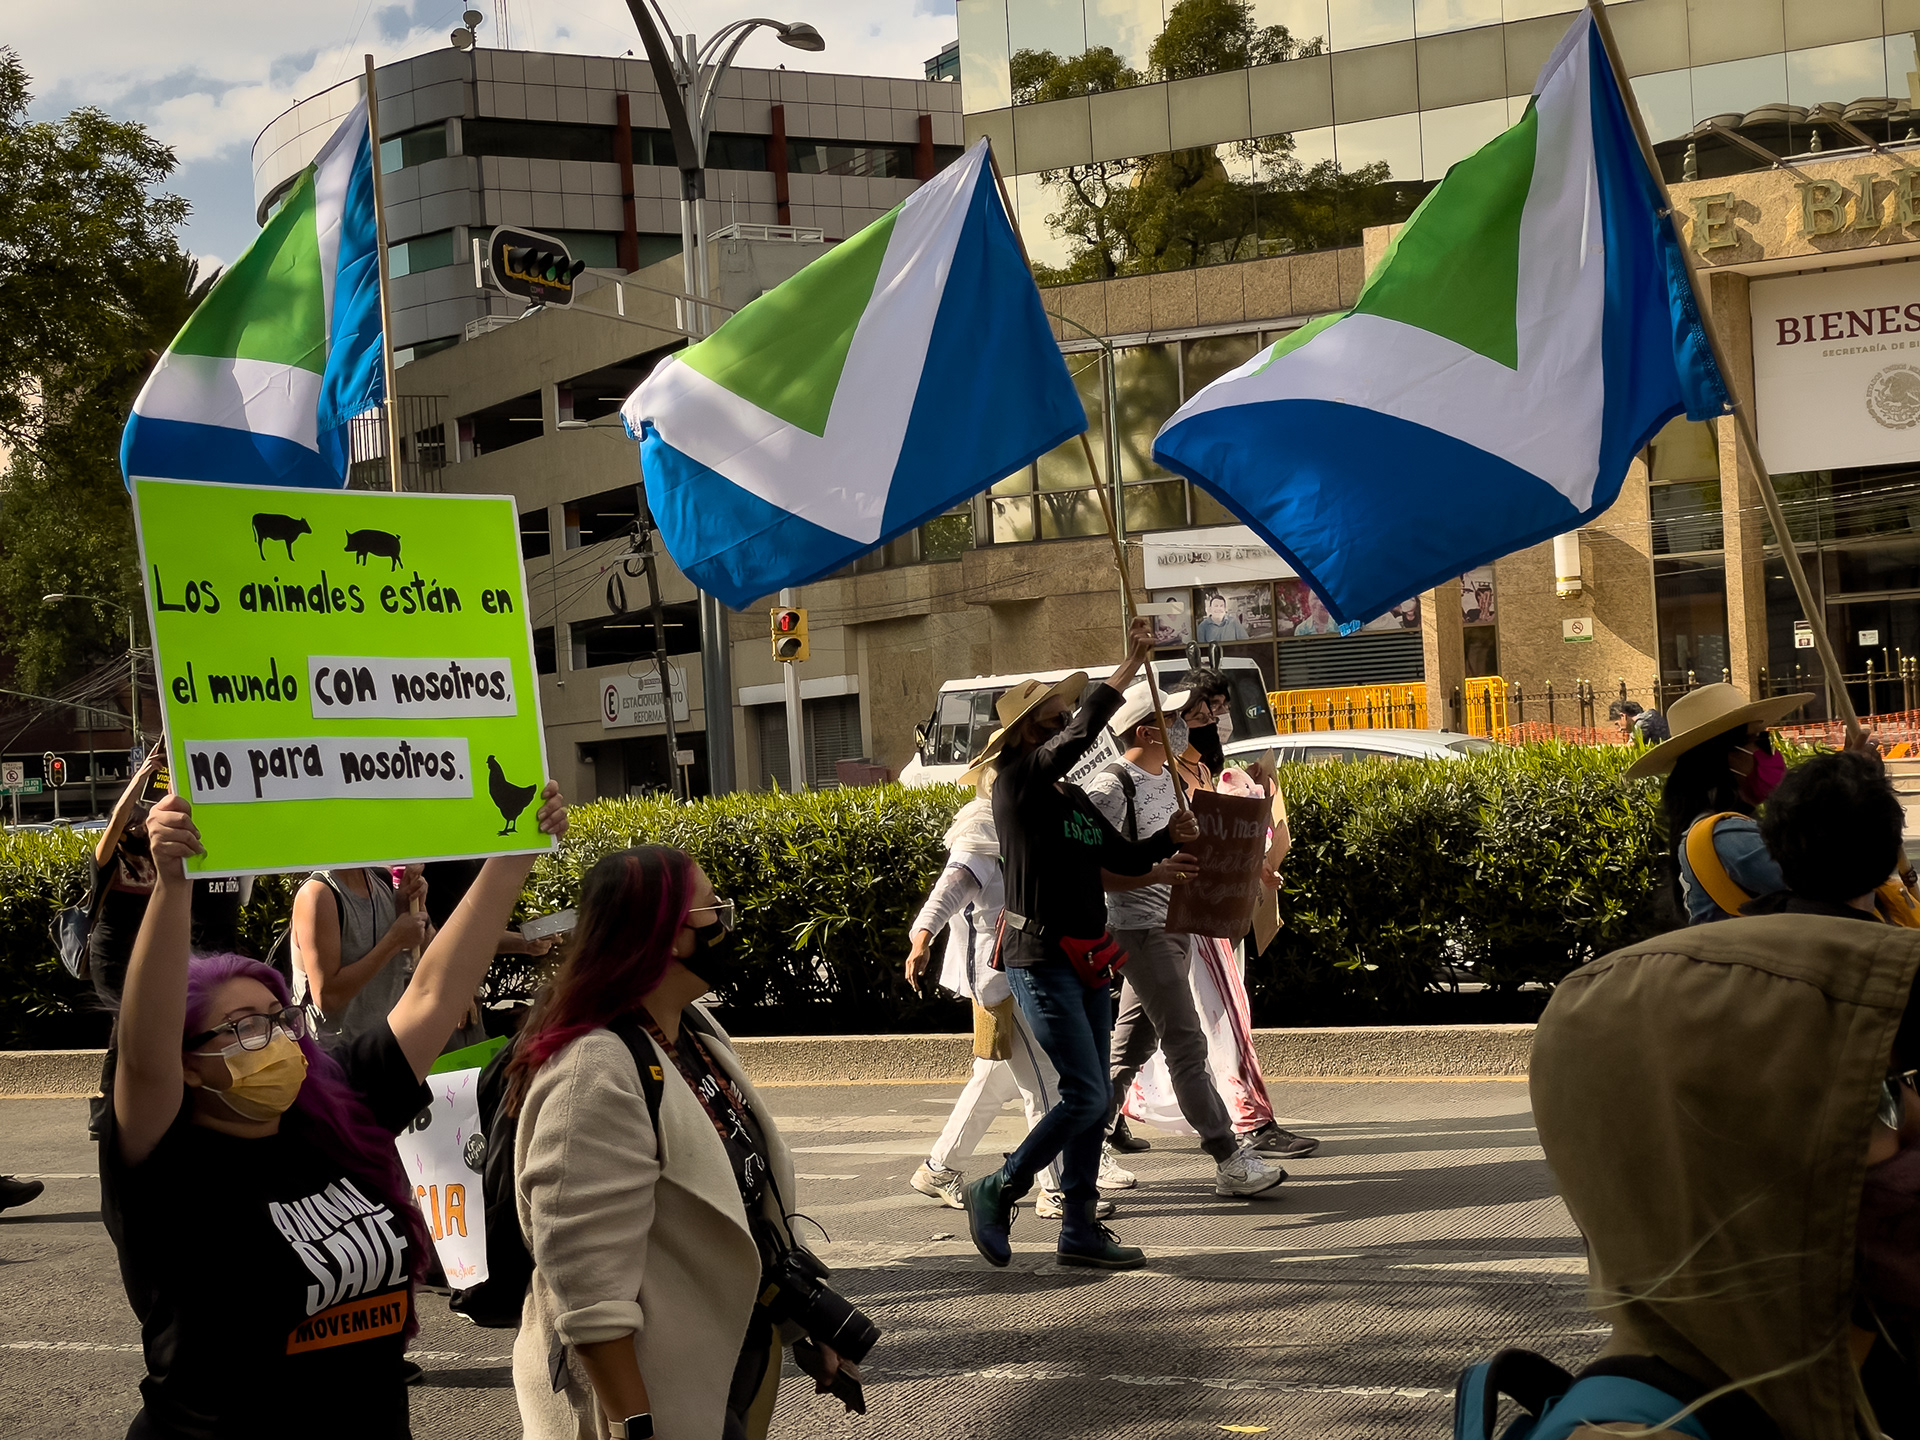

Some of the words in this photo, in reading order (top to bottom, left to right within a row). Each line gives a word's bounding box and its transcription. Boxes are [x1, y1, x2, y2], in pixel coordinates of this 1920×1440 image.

[1775, 303, 1920, 346] BIENES
[1822, 342, 1888, 358] SECRETARÍA
[1891, 342, 1905, 350] DE
[1216, 549, 1232, 561] DE
[153, 563, 221, 614] Los
[239, 569, 365, 615] animales
[380, 567, 462, 615] están
[481, 588, 514, 614] en
[171, 669, 198, 705] el
[207, 656, 298, 704] mundo
[314, 666, 377, 706] con
[391, 660, 512, 704] nosotros,
[633, 709, 663, 724] REFORMA
[190, 751, 232, 792] no
[247, 743, 324, 799] para
[339, 740, 464, 785] nosotros.
[208, 881, 225, 893] EAT
[268, 1177, 386, 1243] ANIMAL
[291, 1209, 409, 1317] SAVE
[295, 1301, 402, 1343] MOVEMENT
